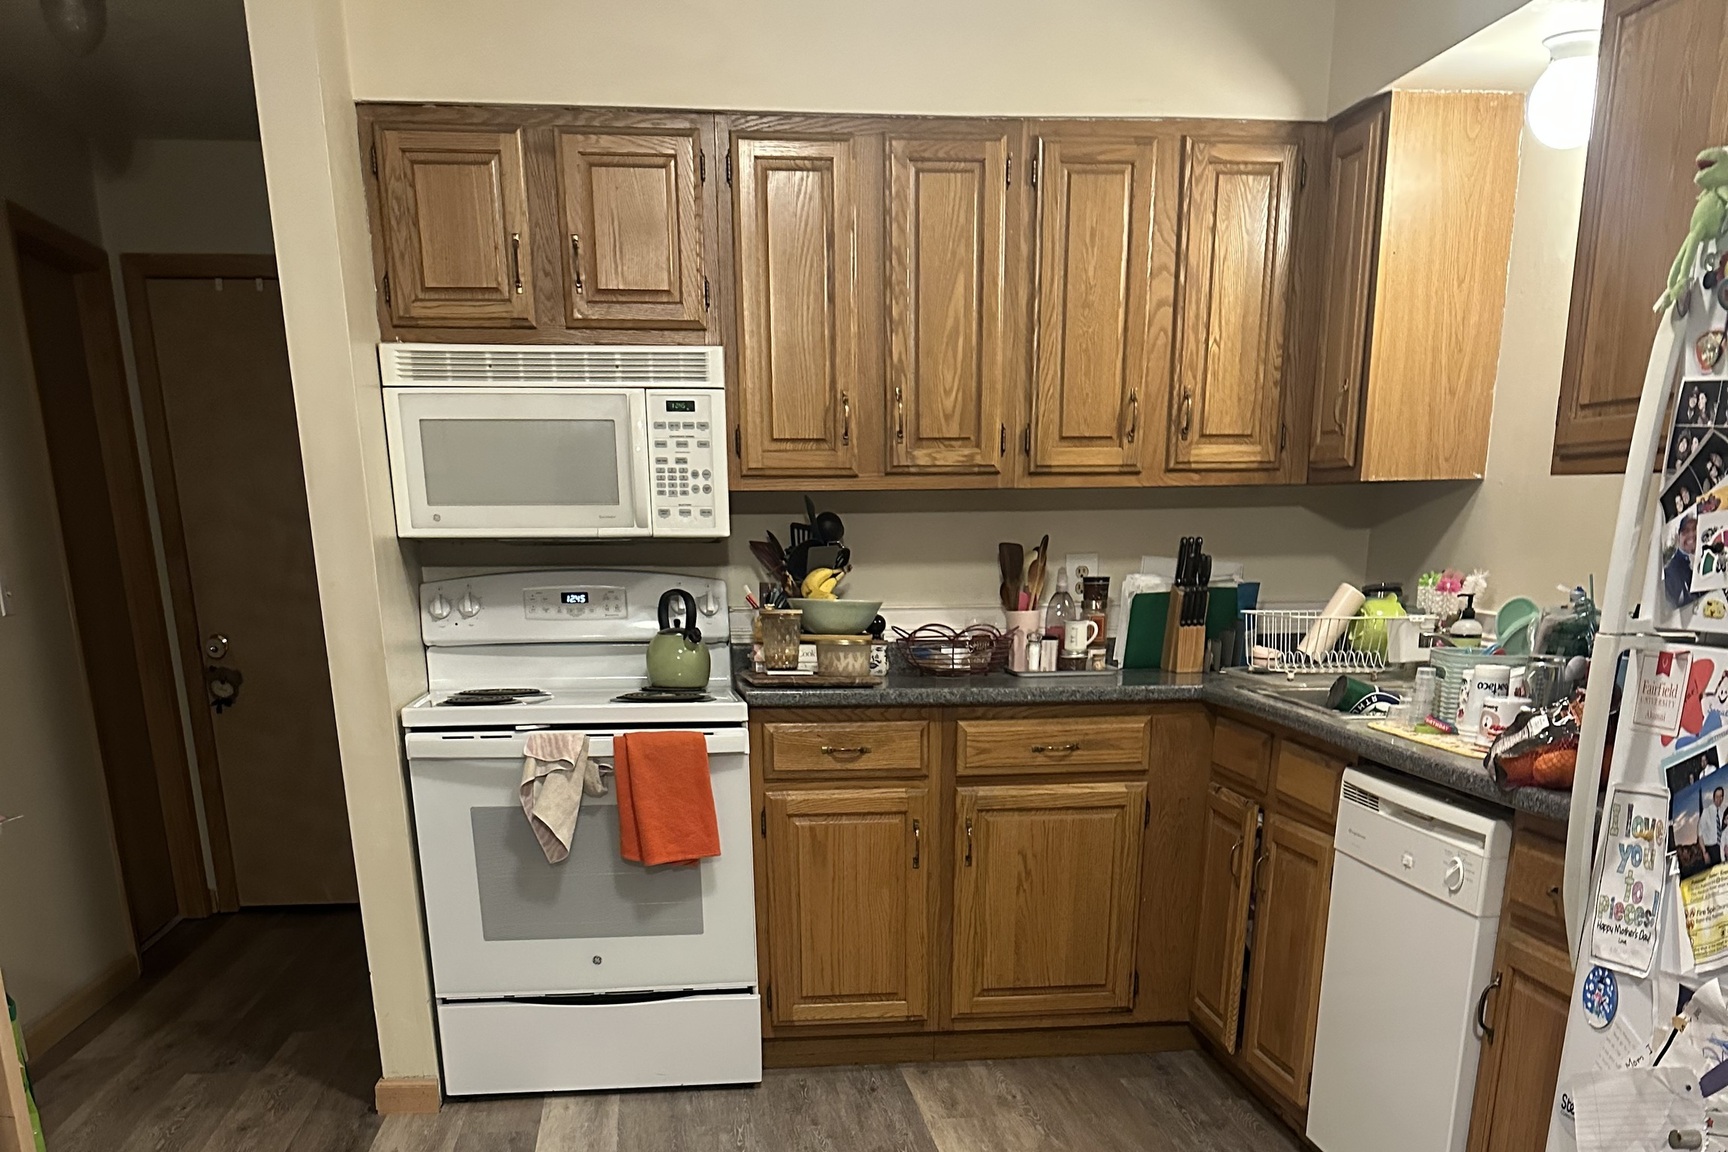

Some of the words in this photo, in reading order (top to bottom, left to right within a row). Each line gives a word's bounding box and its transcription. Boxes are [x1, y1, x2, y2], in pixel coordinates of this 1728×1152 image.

[1642, 680, 1679, 699] Fairfield
[1625, 803, 1665, 847] love
[1616, 842, 1657, 874] you
[1623, 869, 1644, 904] to
[1597, 919, 1614, 934] Happy
[1625, 1055, 1645, 1069] Mom
